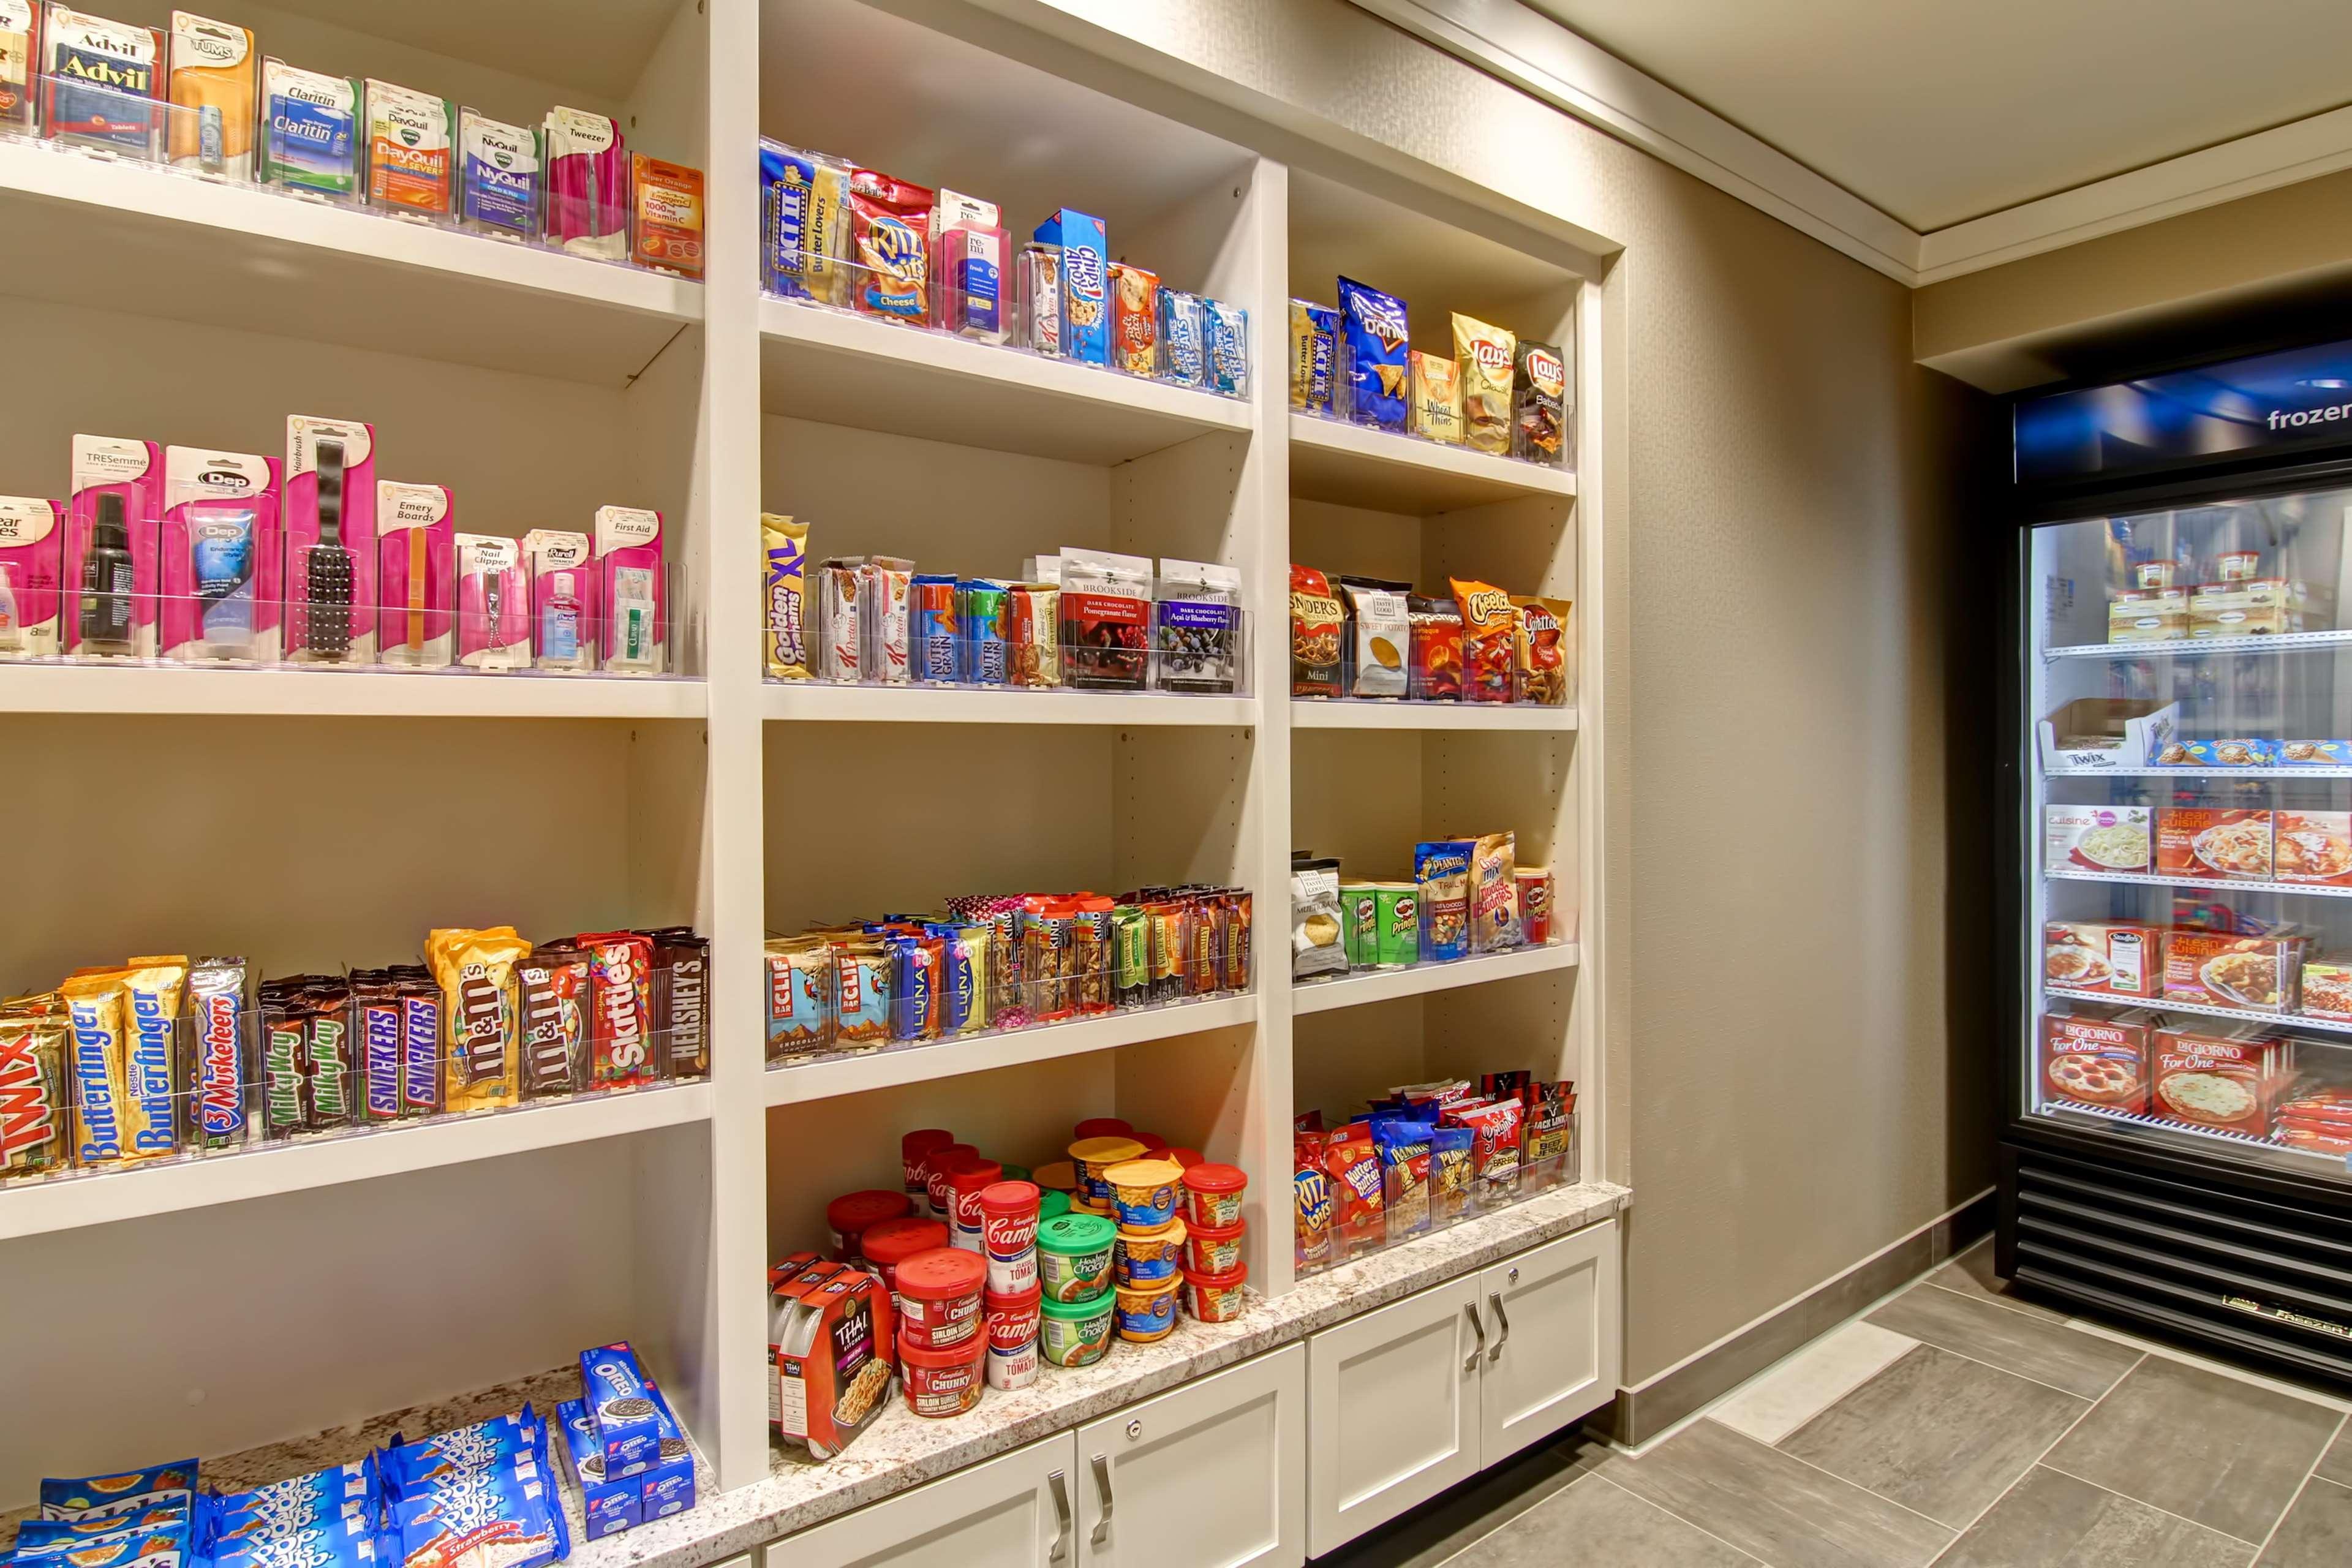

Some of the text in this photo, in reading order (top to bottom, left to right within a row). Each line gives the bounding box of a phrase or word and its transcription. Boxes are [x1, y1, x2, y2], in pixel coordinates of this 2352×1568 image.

[79, 34, 138, 57] Advil
[192, 40, 233, 58] TUMS
[60, 55, 147, 91] Advil
[288, 86, 336, 107] Claritin
[273, 115, 331, 141] Claritin
[570, 128, 606, 143] Tweezer
[376, 141, 443, 168] DayQuil
[476, 163, 530, 191] NyQuil
[664, 178, 692, 190] Orange
[644, 202, 667, 213] 1000
[644, 210, 677, 223] Vitamin
[779, 192, 802, 265] ACT II
[812, 197, 826, 273] Butter Lovers
[870, 221, 924, 259] RITZ
[970, 246, 984, 254] nu
[1079, 246, 1100, 290] Chips
[880, 296, 915, 307] Cheese
[1041, 320, 1059, 344] K
[1176, 317, 1199, 376] TREATS
[1222, 323, 1246, 382] TREATS
[1472, 341, 1511, 368] Lay's
[1298, 335, 1309, 393] Butter Lovers
[1532, 355, 1563, 382] Lay's
[1427, 399, 1451, 413] Wheat
[1427, 413, 1452, 426] Thins
[86, 453, 146, 467] TRESemmé
[293, 435, 303, 472] Hairbrush
[209, 473, 246, 488] Dep
[397, 510, 435, 522] Boards
[399, 502, 433, 513] Emery
[204, 526, 237, 537] Dep
[615, 522, 651, 533] First Aid
[474, 556, 508, 567] Clipper
[480, 549, 500, 559] Nail
[548, 548, 576, 559] Purell
[767, 538, 805, 587] XL
[1083, 583, 1137, 597] BROOKSIDE
[1177, 592, 1229, 603] BROOKSIDE
[1083, 606, 1137, 619] Pomegranate flavor
[1409, 612, 1463, 625] popchips
[1469, 591, 1512, 624] Cheetos
[769, 586, 797, 665] Golden
[788, 591, 806, 665] Grahams
[1191, 614, 1217, 625] Blueberry
[1360, 622, 1409, 632] SWEET POTATO
[835, 616, 859, 668] K Protein
[884, 614, 907, 666] K Protein
[930, 636, 943, 675] NUTRI
[940, 636, 952, 676] GRAIN
[982, 641, 993, 679] NUTRI
[992, 641, 1003, 679] GRAIN
[1306, 670, 1329, 681] Mini
[2150, 715, 2171, 739] Twix
[2067, 753, 2107, 767] Twix
[2048, 815, 2092, 826] cuisine
[2160, 817, 2213, 829] cuisine
[1478, 852, 1502, 870] Chex
[1438, 880, 1459, 891] TRAIL
[1003, 912, 1012, 941] KIND
[1049, 919, 1060, 949] KIND
[1093, 912, 1102, 942] KIND
[1230, 924, 1239, 949] VALLEY
[1201, 927, 1210, 951] VALLEY
[2167, 944, 2220, 957] cuisine
[773, 960, 791, 1005] CLIF
[840, 957, 859, 1000] CLIF
[959, 960, 968, 1017] LUNA
[605, 944, 646, 1068] Skittles
[671, 959, 703, 1058] HERSHEY'S
[914, 968, 926, 1027] LUNA
[774, 1005, 791, 1014] BAR
[407, 1000, 436, 1102] SNICKERS
[2050, 1039, 2073, 1052] For
[2072, 1039, 2100, 1052] One
[132, 988, 174, 1150] Butterfinger
[203, 996, 239, 1128] 3 Musketeers
[311, 1019, 347, 1114] Milky Way
[368, 1009, 398, 1112] SNICKERS
[2160, 1054, 2184, 1070] For
[2184, 1054, 2215, 1069] One
[72, 1001, 123, 1162] Butterfinger
[266, 1032, 304, 1126] Milky Way
[1539, 1138, 1562, 1150] BEEF
[1345, 1158, 1374, 1186] Nutter
[1354, 1166, 1380, 1197] Butter
[1294, 1172, 1328, 1212] RITZ
[1305, 1200, 1331, 1231] bits
[1303, 1237, 1329, 1256] Peanut
[1010, 1264, 1036, 1281] TOMATO
[1073, 1260, 1105, 1276] Choice
[950, 1298, 981, 1320] CHUNKY
[835, 1311, 868, 1346] THAI
[931, 1327, 958, 1340] SIRLOIN
[1077, 1324, 1107, 1339] Choice
[843, 1332, 865, 1352] KITCHEN
[785, 1363, 801, 1373] THAI
[1005, 1359, 1036, 1376] TOMATO
[594, 1363, 633, 1397] OREO
[932, 1373, 971, 1391] CHUNKY
[916, 1397, 940, 1408] SIRLOIN
[620, 1436, 648, 1452] OREO
[657, 1476, 684, 1493] OREO
[601, 1493, 629, 1509] OREO
[449, 1521, 511, 1556] Strawberry
